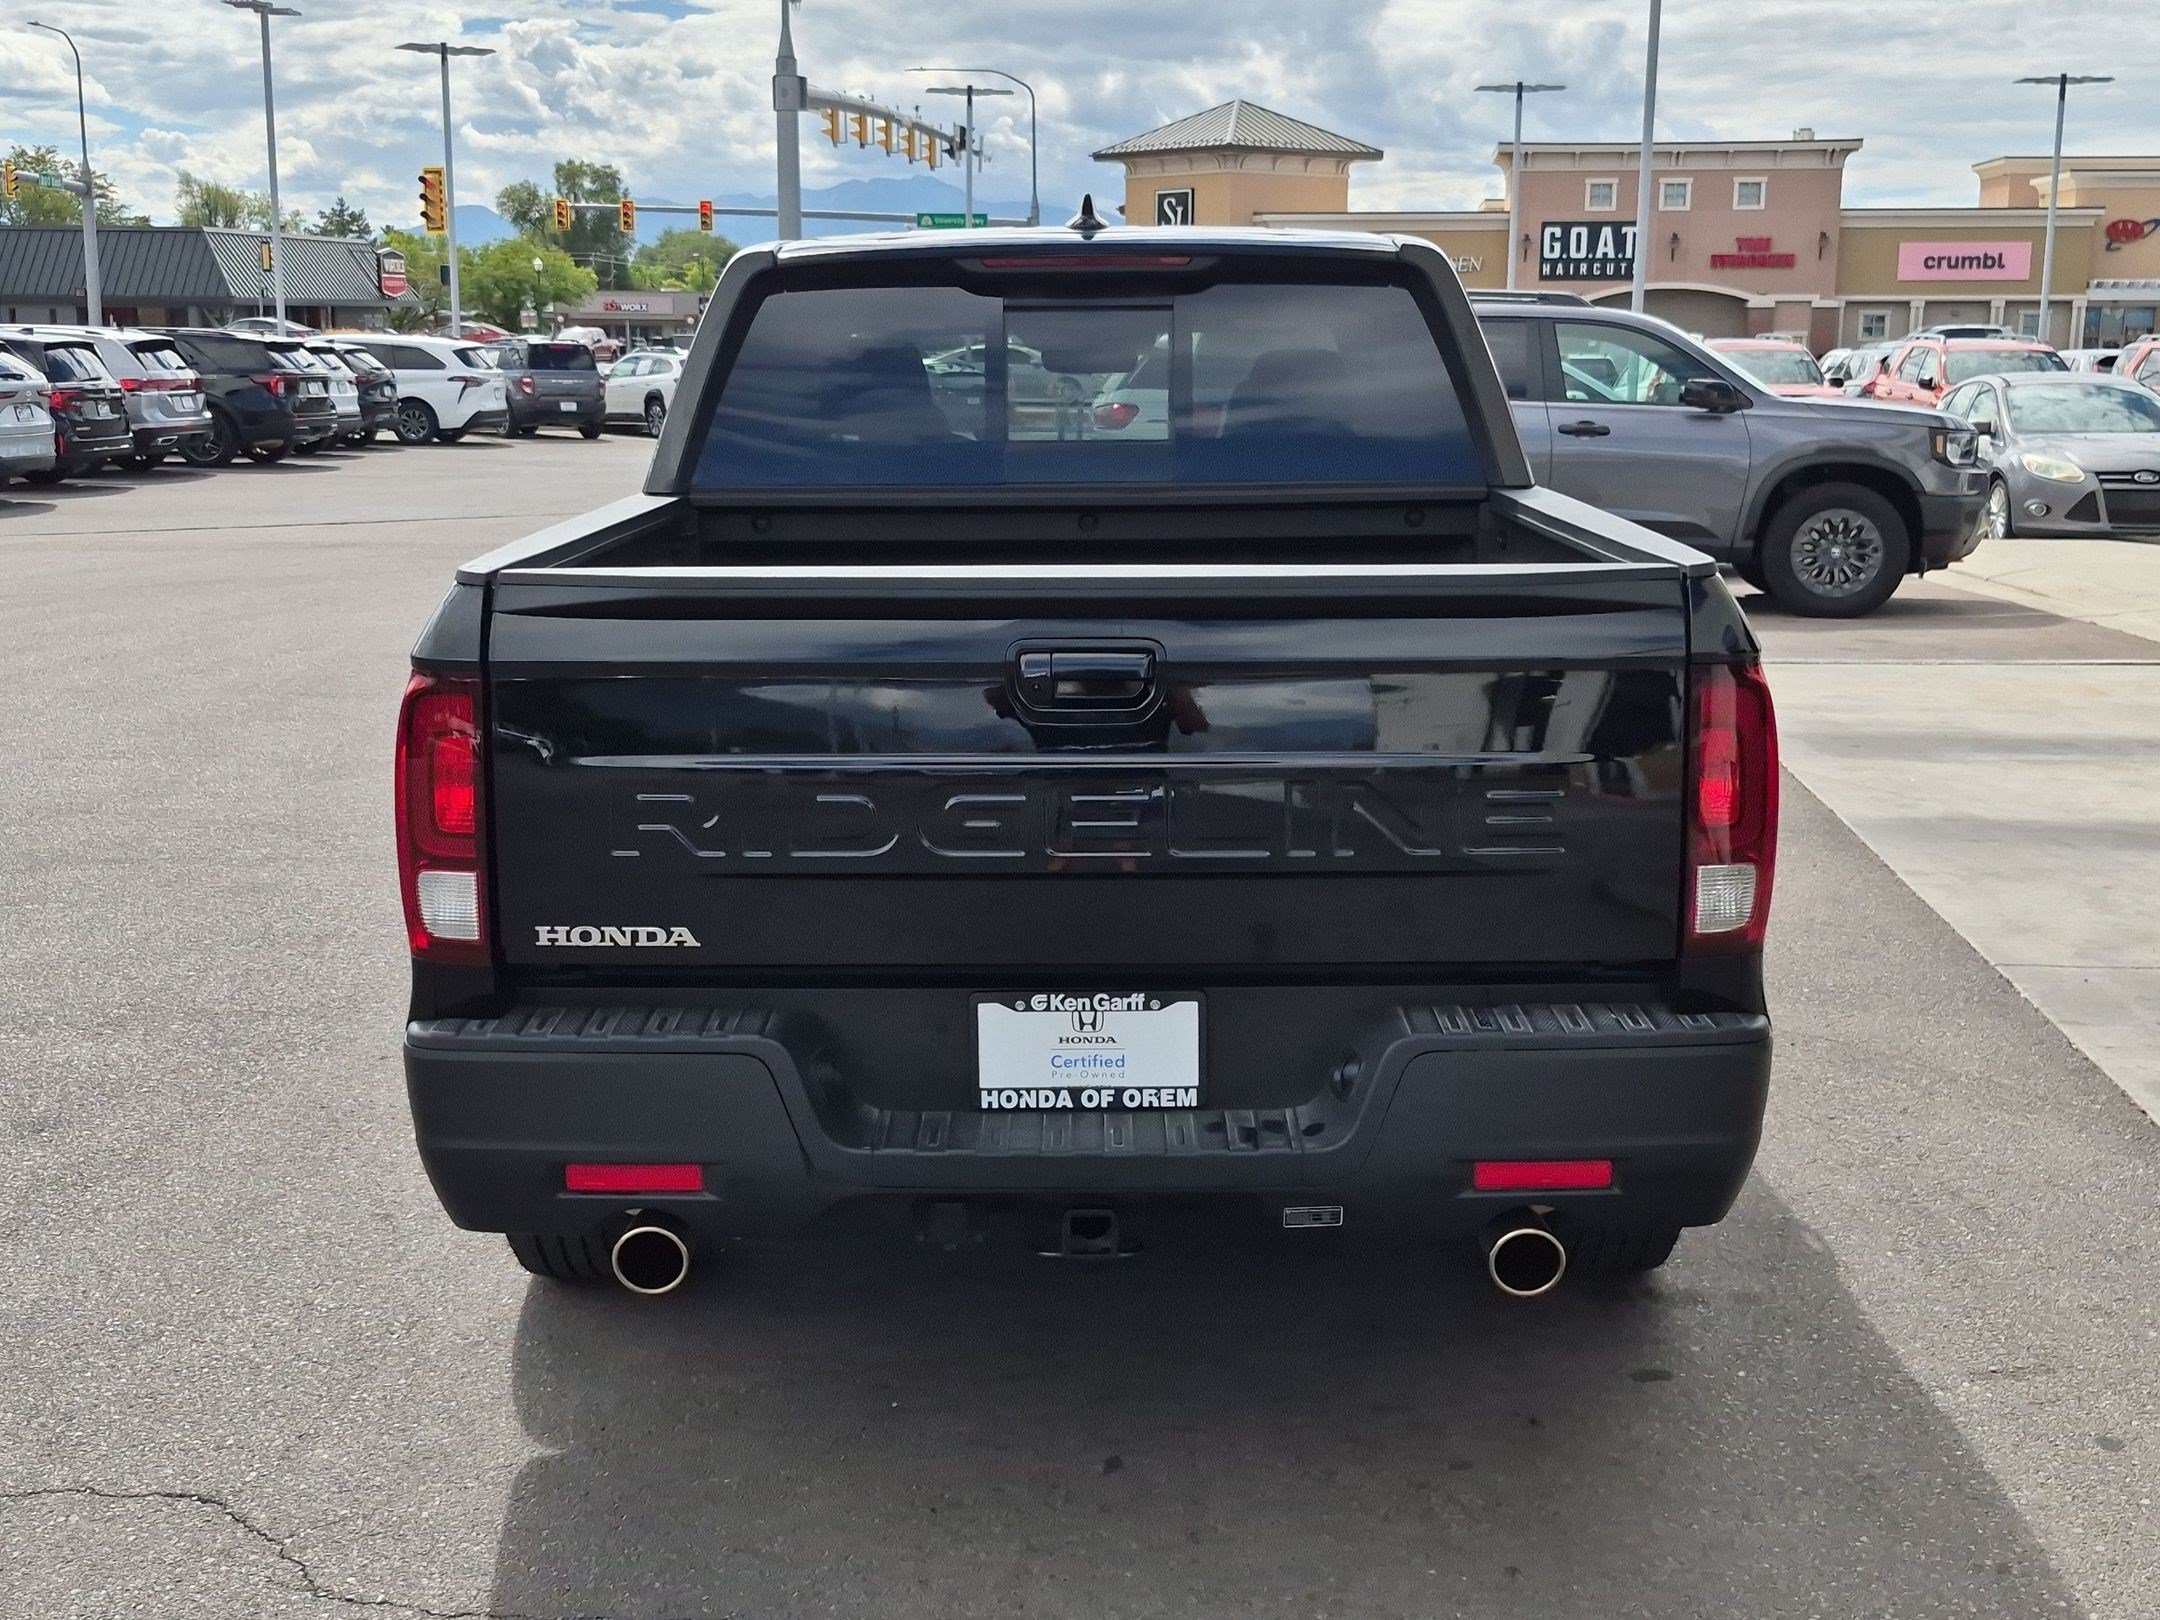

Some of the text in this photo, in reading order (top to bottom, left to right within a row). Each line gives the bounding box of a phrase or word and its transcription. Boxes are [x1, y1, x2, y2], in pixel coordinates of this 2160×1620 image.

[1542, 262, 1635, 276] HAIRCUT
[1923, 252, 2006, 270] crumbl
[610, 780, 1566, 857] RIDGELINE
[534, 925, 702, 947] HONDA
[1049, 993, 1091, 1011] Ken
[1092, 992, 1146, 1011] Garff
[1058, 1036, 1118, 1045] HONDA
[1050, 1053, 1126, 1068] Certified
[1051, 1070, 1125, 1079] Pre-Owned
[980, 1087, 1198, 1110] HONDA OF OREM
